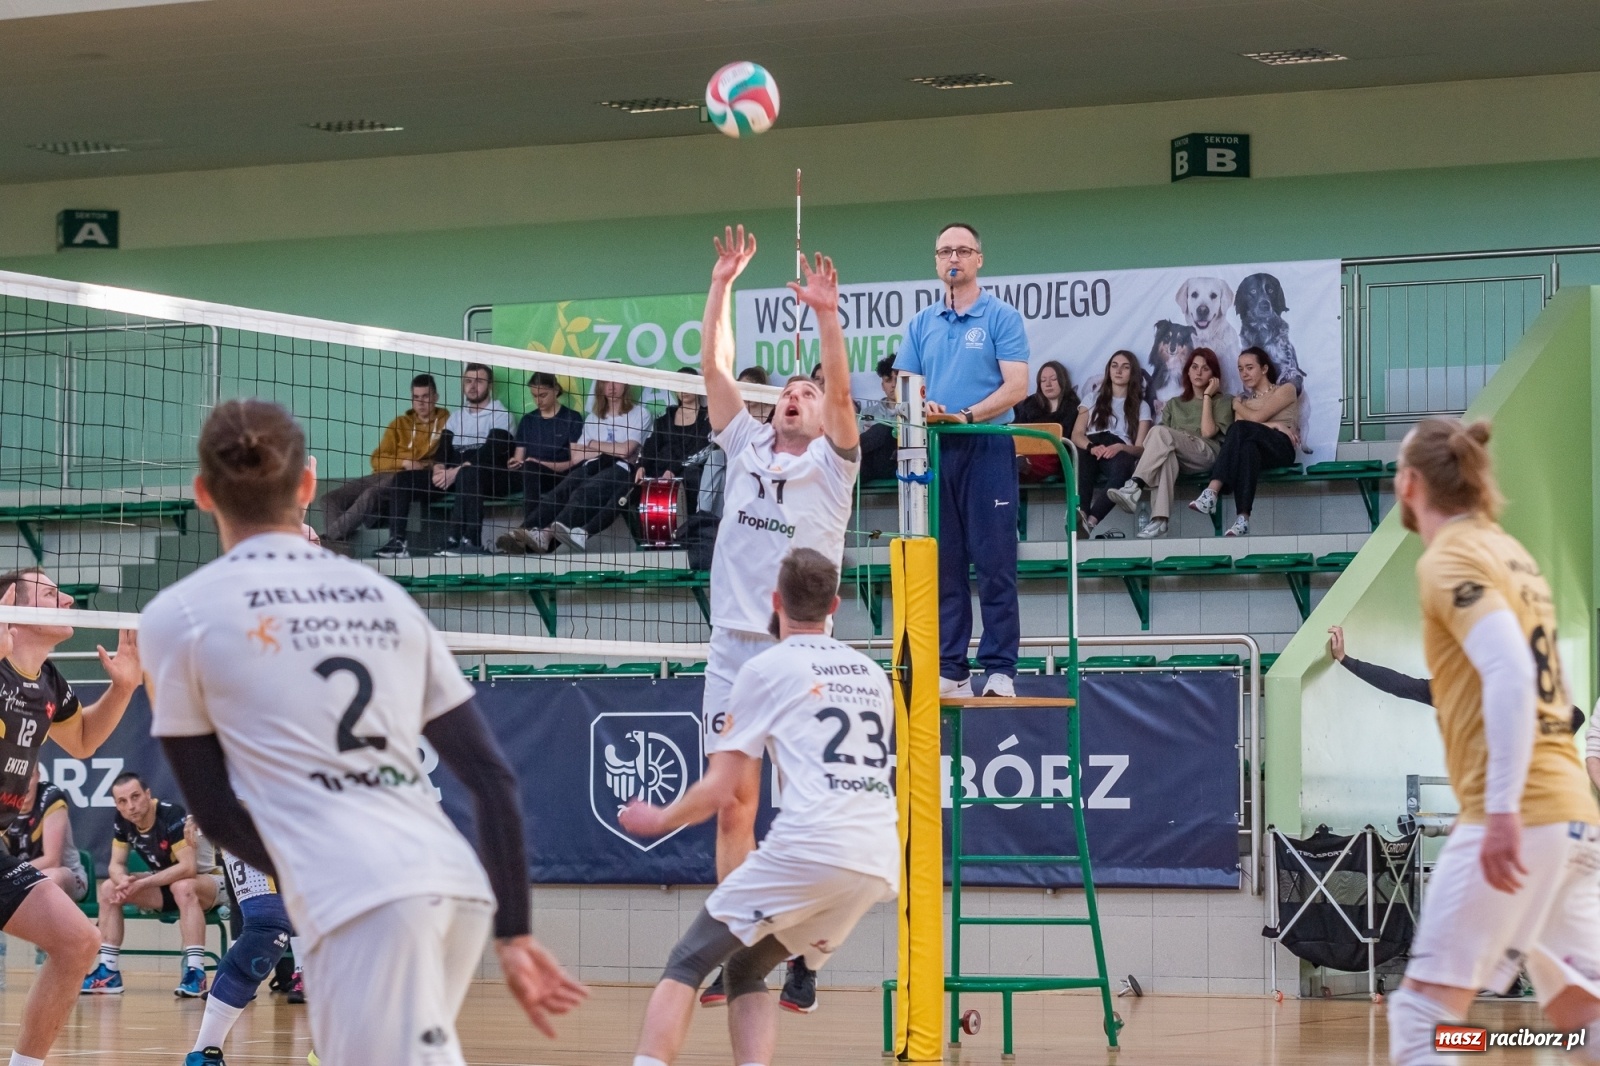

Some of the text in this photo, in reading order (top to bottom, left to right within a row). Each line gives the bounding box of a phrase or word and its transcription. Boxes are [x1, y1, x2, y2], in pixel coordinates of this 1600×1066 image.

[1204, 135, 1239, 145] SEKTOR
[1175, 150, 1189, 176] B
[1206, 147, 1238, 172] B
[72, 222, 110, 245] A
[755, 290, 904, 334] WSZSTKO
[984, 278, 1111, 320] WOJEGO
[591, 319, 704, 367] ZOO
[738, 510, 796, 539] TropiDog
[244, 585, 385, 609] ZIELIŃSKI
[287, 616, 400, 635] ZOO MAR
[812, 662, 870, 676] ŚWIDER
[827, 682, 853, 694] ZOO
[313, 656, 388, 754] 2
[17, 717, 38, 748] 12
[704, 711, 726, 735] 16
[815, 706, 888, 769] 23
[4, 756, 29, 776] ENTER
[229, 860, 247, 889] 13
